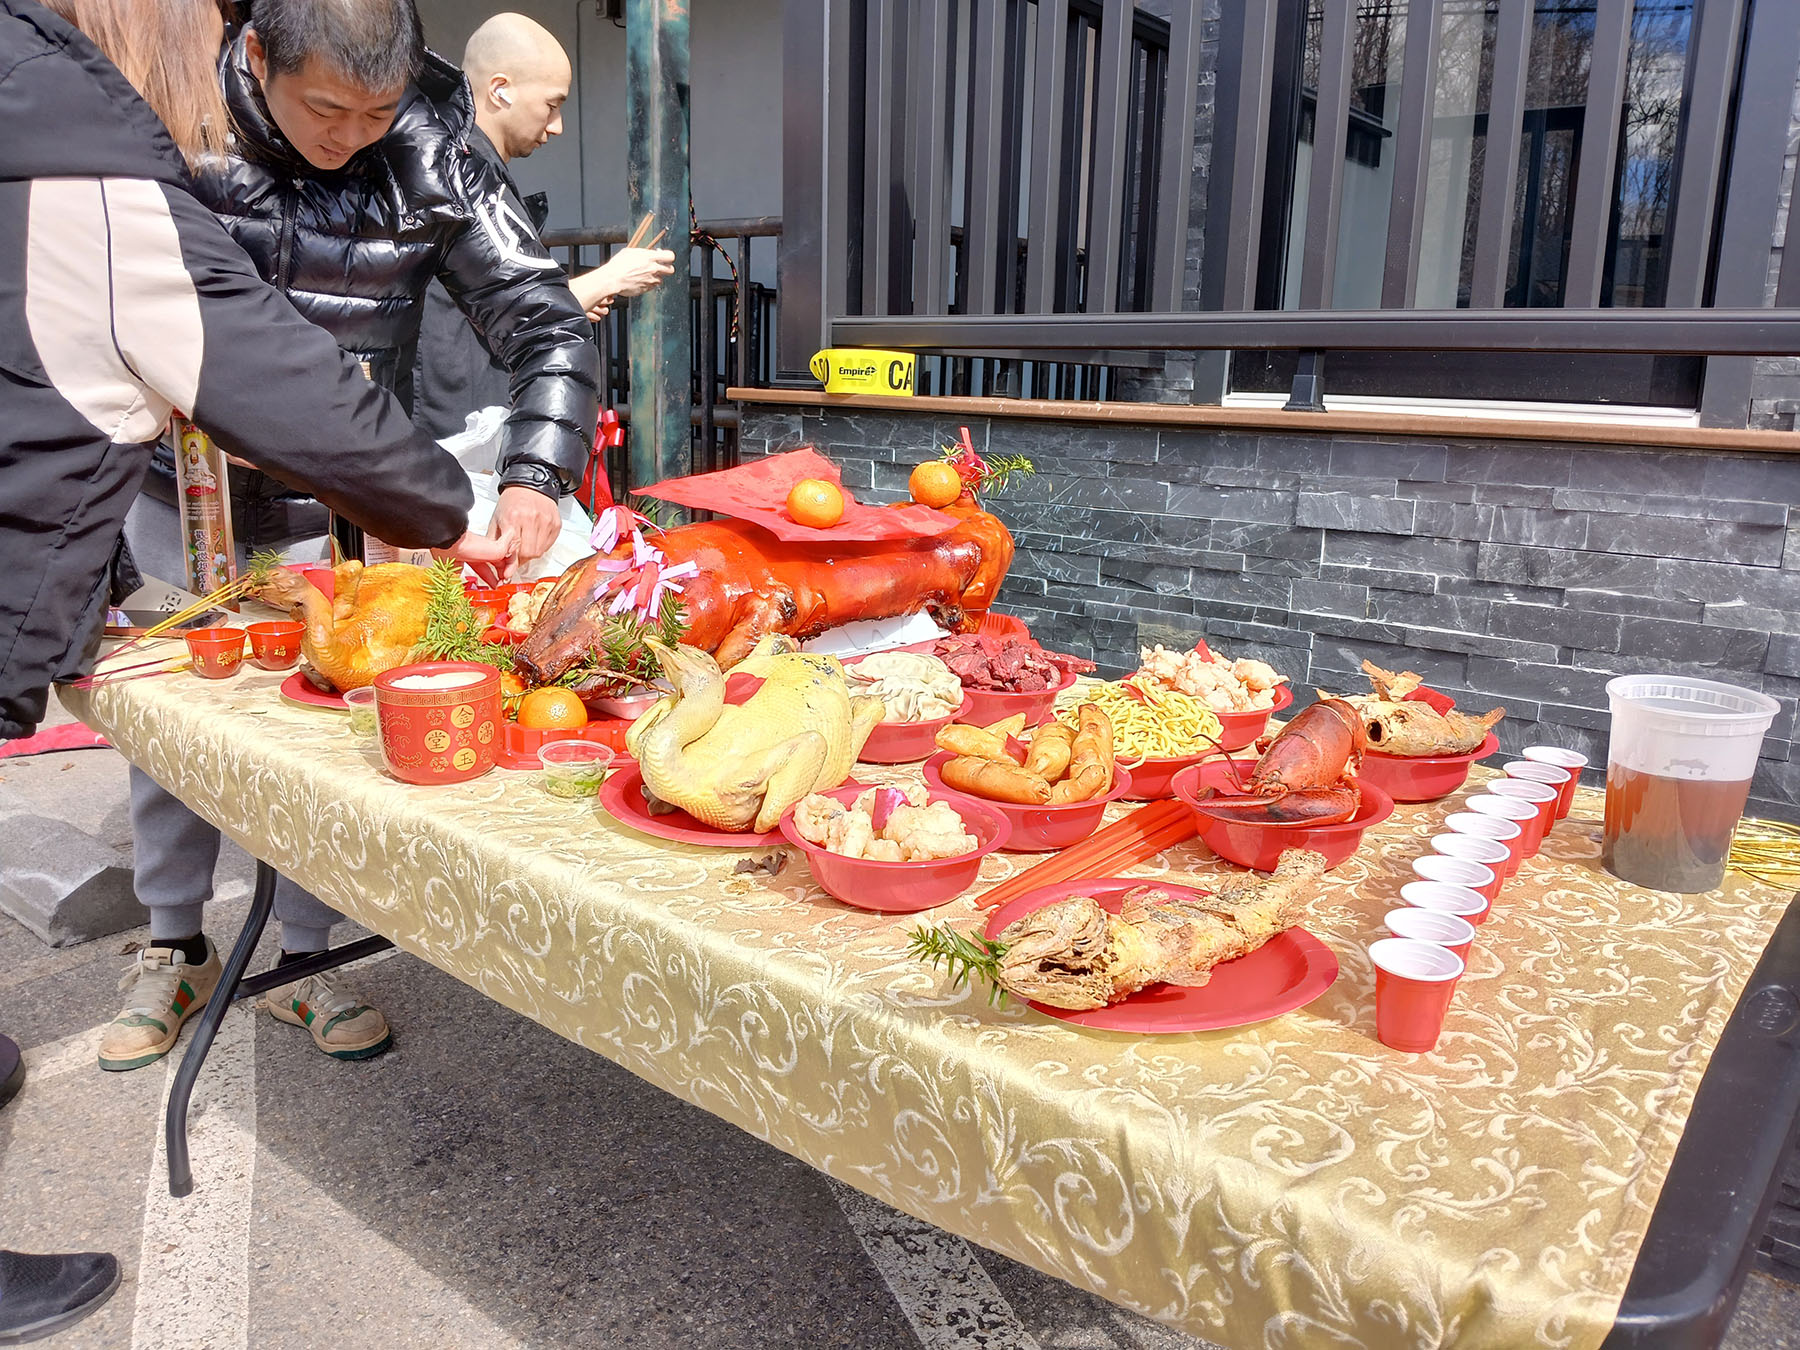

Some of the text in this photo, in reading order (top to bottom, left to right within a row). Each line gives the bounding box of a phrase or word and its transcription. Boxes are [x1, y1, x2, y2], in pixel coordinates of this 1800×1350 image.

[838, 366, 871, 377] Empire
[456, 707, 473, 725] 金
[427, 732, 446, 750] 堂
[457, 751, 474, 767] 玉
